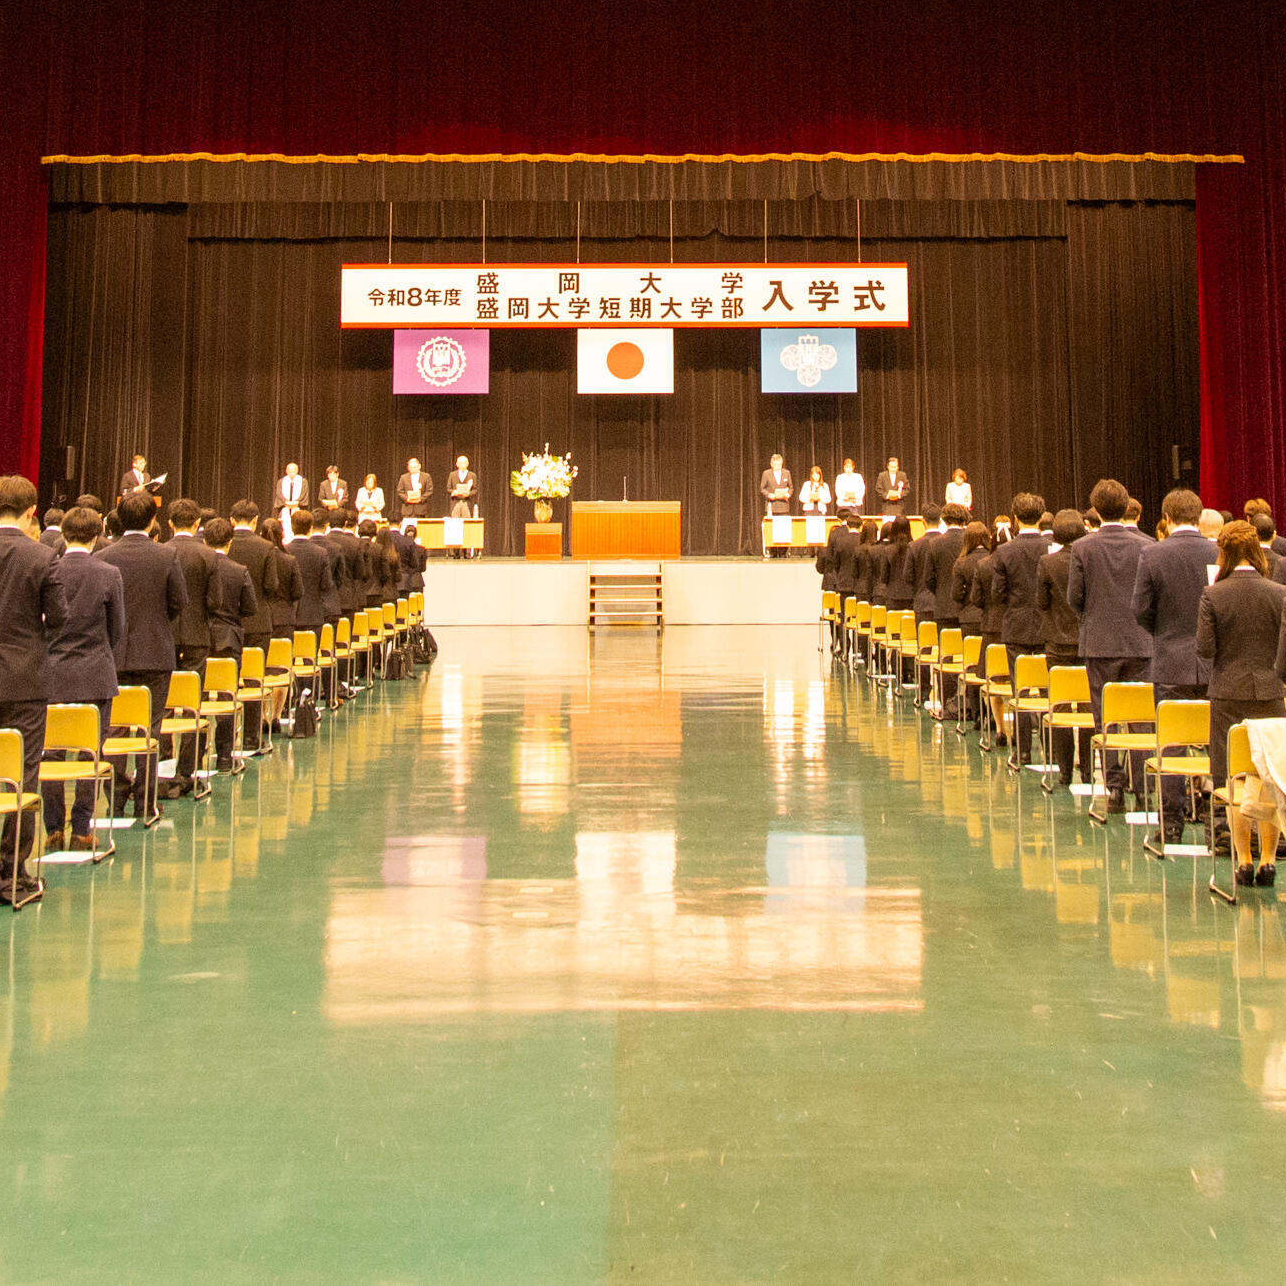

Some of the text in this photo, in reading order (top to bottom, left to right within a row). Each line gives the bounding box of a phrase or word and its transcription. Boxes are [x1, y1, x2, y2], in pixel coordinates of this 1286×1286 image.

[477, 272, 743, 294] 盛岡大学
[367, 287, 462, 307] 令和8年度
[762, 280, 886, 312] 入学式
[477, 297, 744, 319] 盛岡大学短期大学部
